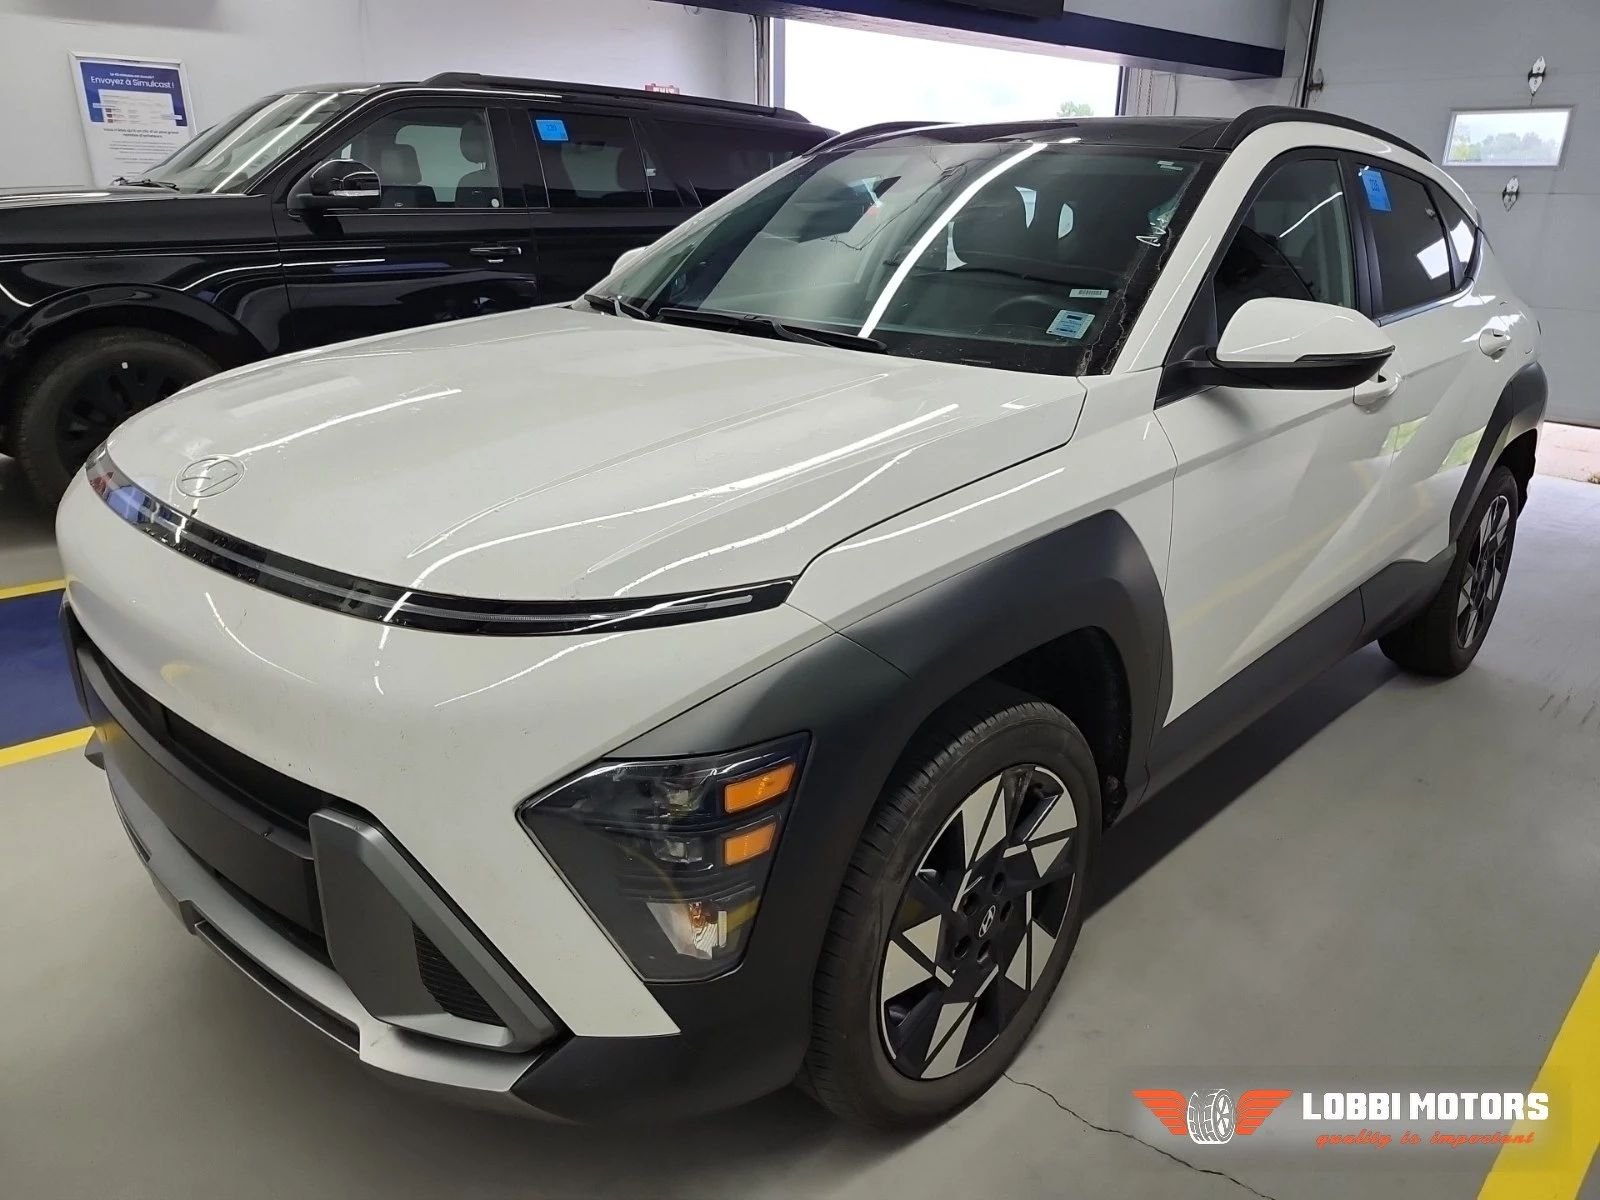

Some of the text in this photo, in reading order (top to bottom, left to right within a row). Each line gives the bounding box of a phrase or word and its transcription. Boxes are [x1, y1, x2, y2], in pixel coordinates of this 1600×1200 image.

[91, 76, 124, 86] Envoyez
[125, 78, 131, 86] à
[132, 79, 171, 88] Simulcast
